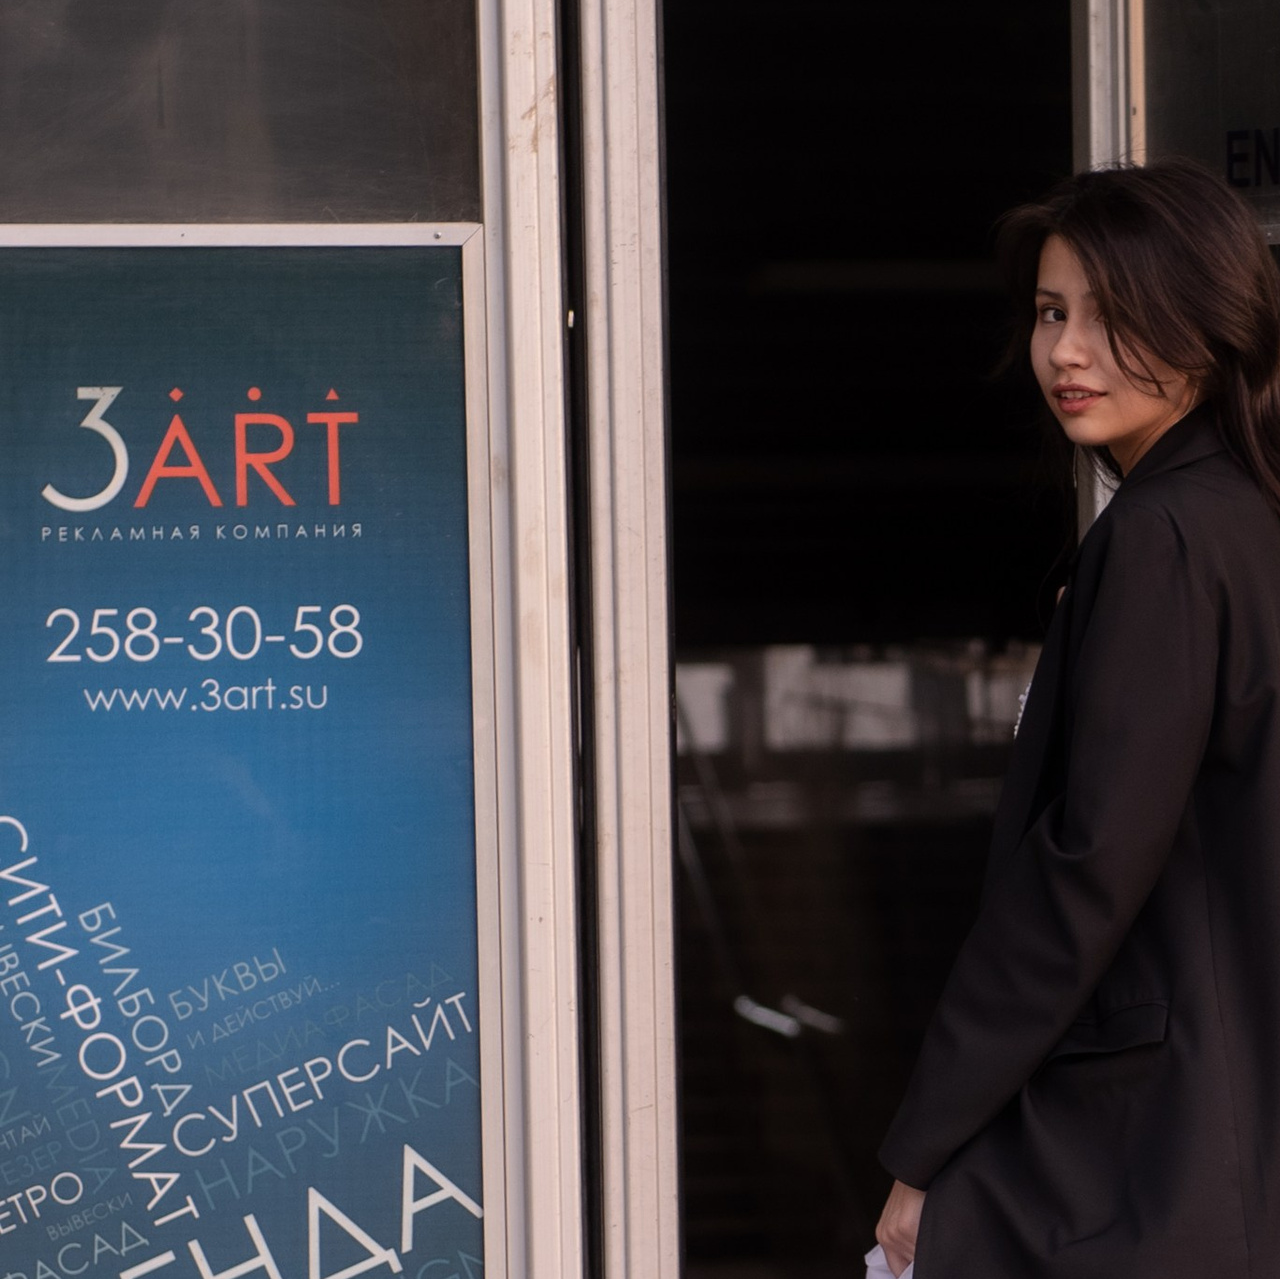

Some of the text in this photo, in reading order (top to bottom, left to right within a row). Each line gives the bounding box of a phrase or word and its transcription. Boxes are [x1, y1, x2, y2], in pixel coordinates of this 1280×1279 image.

[41, 386, 359, 513] 3ART
[41, 523, 362, 542] РЕКЛАМНАЯ КОМПАНИЯ
[45, 604, 364, 663] 258-30-58
[83, 678, 329, 712] www.3art.su
[78, 901, 193, 1118] БИЛБОРД
[168, 948, 288, 1020] БУКВЫ
[186, 1030, 206, 1050] И
[172, 991, 473, 1157] СУПЕРСАЙТ
[194, 1057, 482, 1211] НАРУЖКА
[45, 1192, 134, 1241] ВЫВЕСКИ
